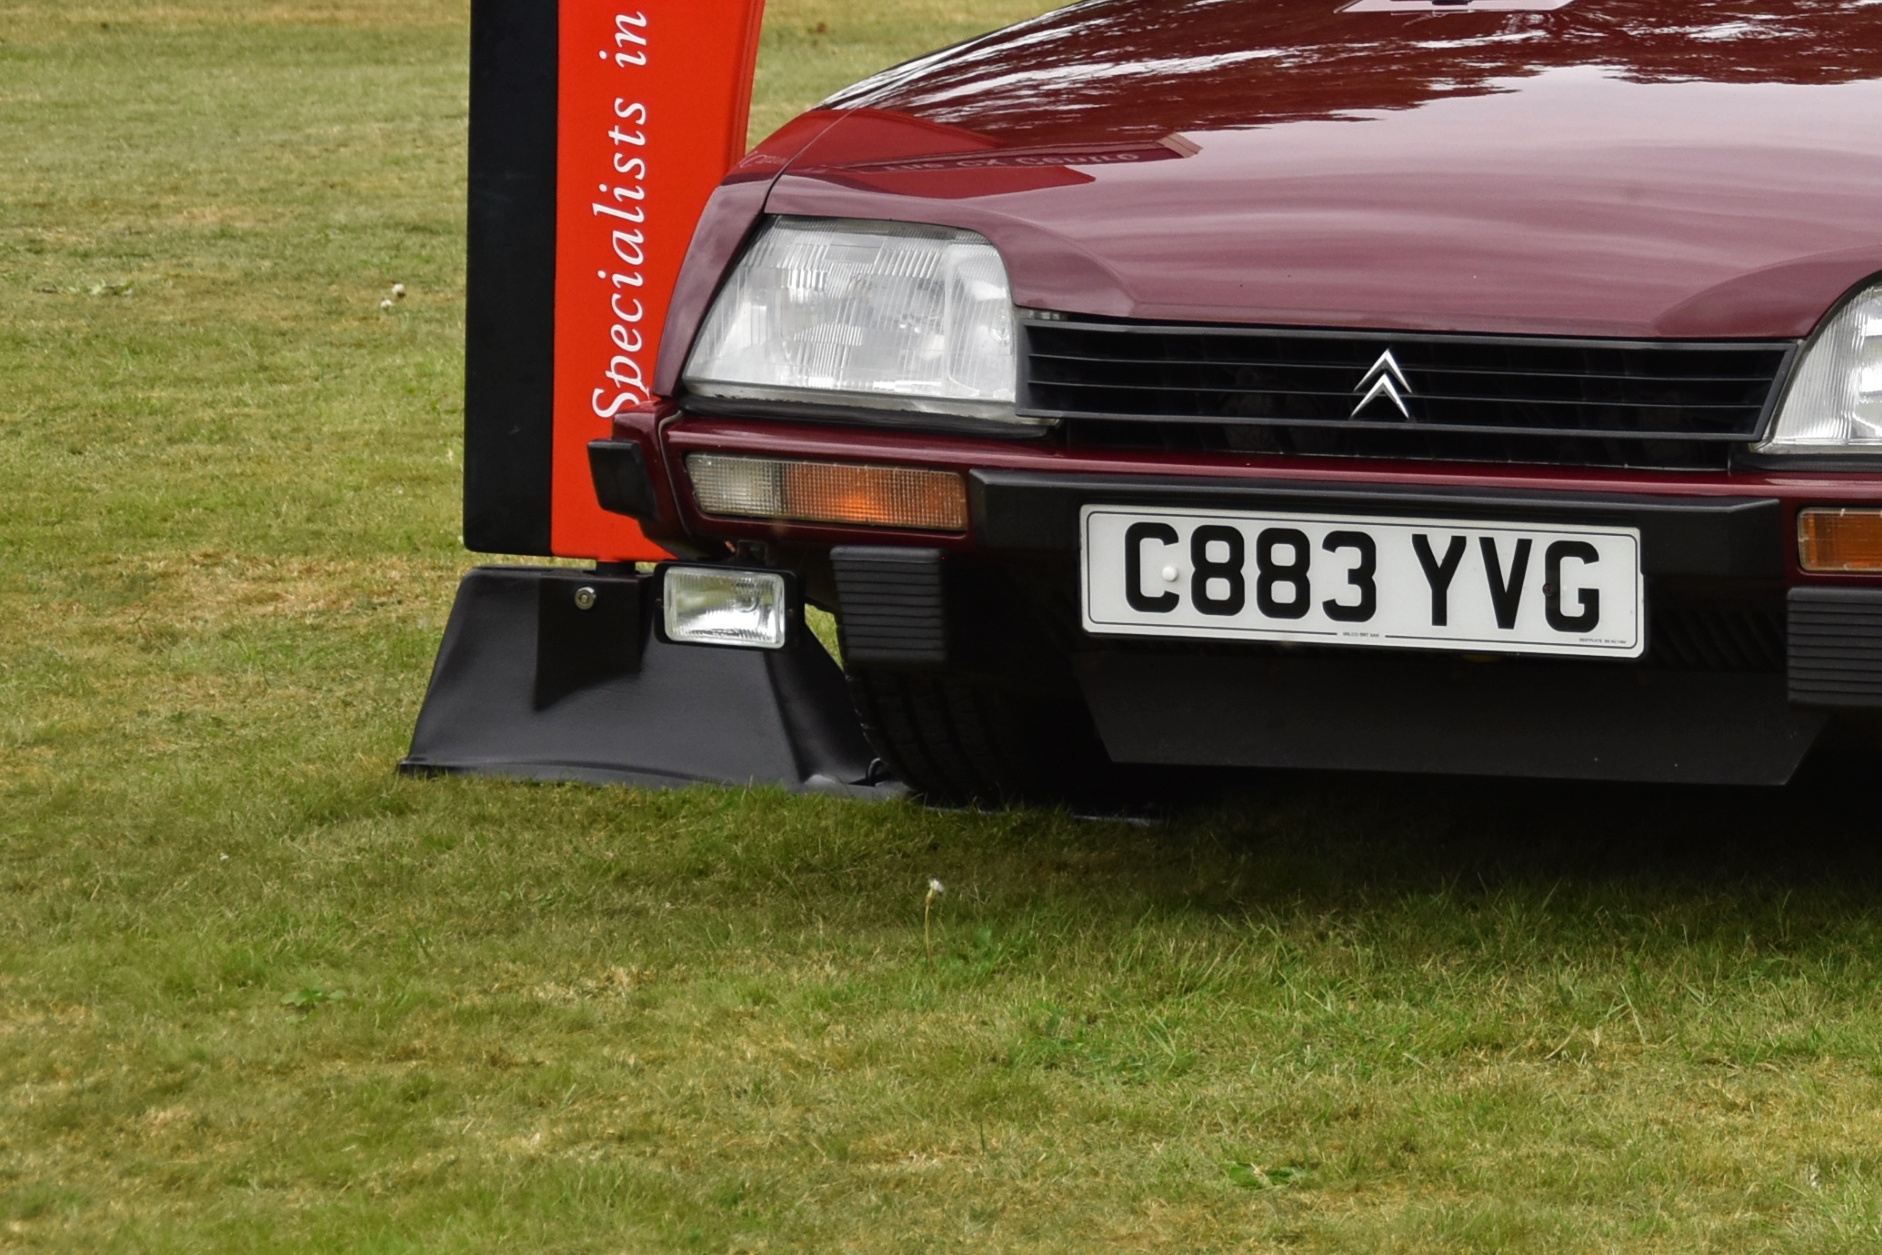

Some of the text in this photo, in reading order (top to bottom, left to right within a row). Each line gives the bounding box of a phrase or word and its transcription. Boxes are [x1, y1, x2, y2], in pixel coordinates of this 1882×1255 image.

[599, 11, 647, 68] in
[592, 97, 650, 418] Specialists
[1124, 521, 1601, 634] C883 YVG
